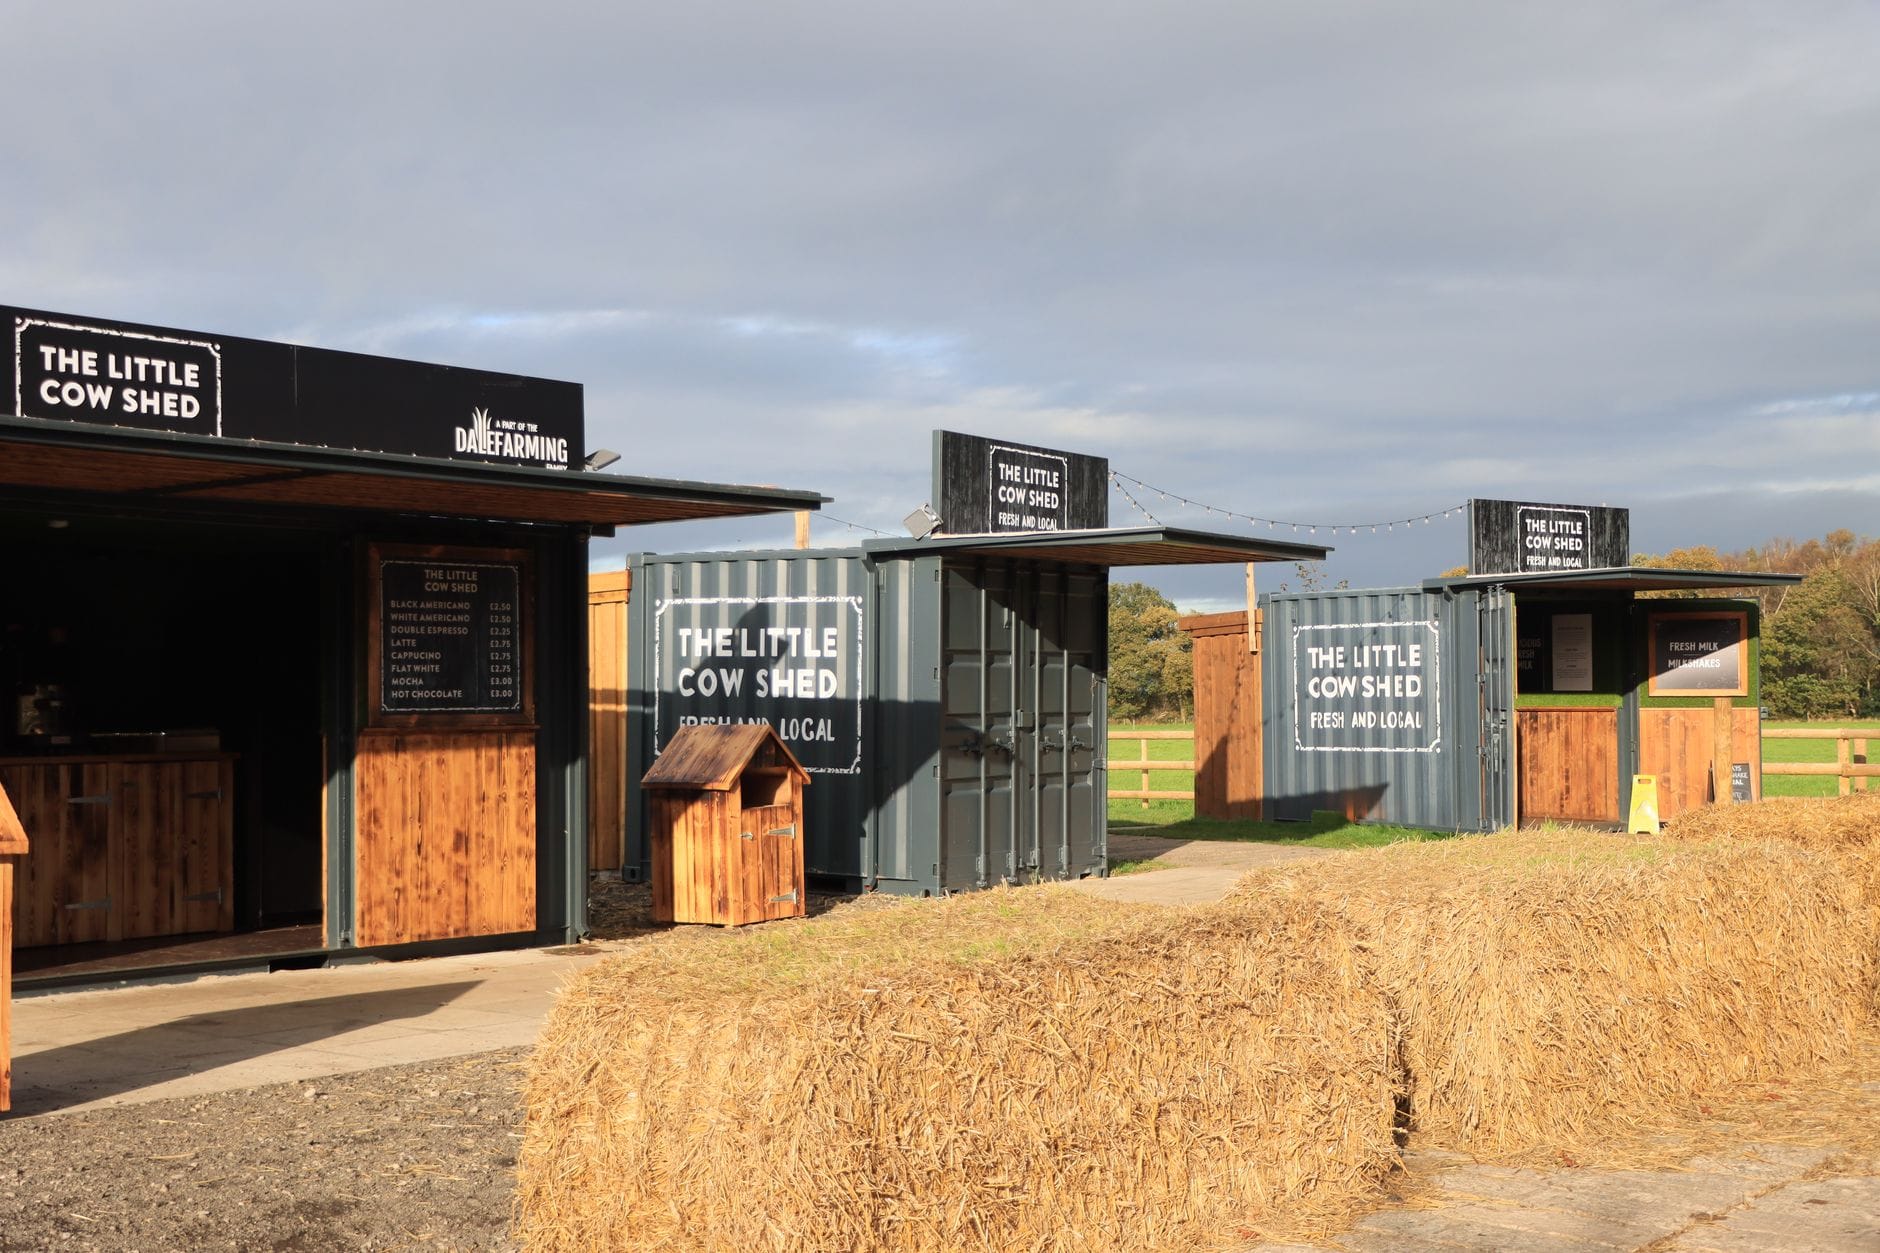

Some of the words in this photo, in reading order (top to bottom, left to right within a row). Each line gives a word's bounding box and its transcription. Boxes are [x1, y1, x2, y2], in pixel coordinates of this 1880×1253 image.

[40, 346, 97, 376] THE
[108, 356, 200, 388] LITTLE
[40, 380, 113, 410] COW
[122, 389, 200, 420] SHED
[495, 420, 501, 428] A
[502, 420, 516, 430] PART
[518, 423, 526, 431] OF
[527, 424, 538, 432] THE
[455, 426, 568, 462] DALEFARMING
[999, 464, 1020, 482] THE
[1024, 467, 1059, 488] LITTLE
[998, 486, 1026, 504] COW
[1029, 490, 1059, 509] SHED
[999, 512, 1020, 526] FRESH
[1022, 515, 1036, 528] AND
[1038, 516, 1058, 531] LOCAL
[1525, 519, 1546, 532] THE
[1549, 521, 1582, 534] LITTLE
[1526, 536, 1551, 549] COW
[1554, 538, 1582, 550] SHED
[1526, 556, 1546, 566] FRESH
[1548, 556, 1561, 567] AND
[1563, 557, 1582, 568] LOCAL
[424, 570, 444, 580] THE
[446, 570, 478, 581] LITTLE
[425, 582, 448, 592] COW
[451, 583, 478, 593] SHED
[390, 600, 418, 608] BLACK
[420, 602, 470, 610] AMERICANO
[490, 603, 511, 611] £2.50
[390, 613, 418, 622] WHITE
[420, 614, 470, 622] AMERICANO
[391, 626, 425, 634] DOUBLE
[427, 626, 468, 635] ESPRESSO
[391, 639, 416, 647] LATTE
[679, 628, 732, 657] THE
[741, 628, 838, 658] LITTLE
[1670, 642, 1696, 651] FRESH
[1699, 642, 1718, 651] MILK
[391, 652, 441, 660] CAPPUCINO
[1307, 646, 1344, 668] THE
[1354, 644, 1421, 667] LITTLE
[392, 664, 412, 672] FLAT
[413, 664, 440, 672] WHITE
[490, 665, 511, 673] £2.75
[1668, 659, 1720, 668] MILKSHAKES
[392, 677, 423, 685] MOCHA
[678, 668, 744, 697] COW
[756, 668, 838, 698] SHED
[1308, 676, 1357, 698] COW
[1362, 674, 1422, 698] SHED
[392, 690, 410, 698] HOT
[412, 690, 462, 698] CHOCOLATE
[1310, 712, 1344, 729] FRESH
[1352, 712, 1376, 728] AND
[1381, 712, 1421, 729] LOCAL
[780, 717, 835, 741] LOCAL
